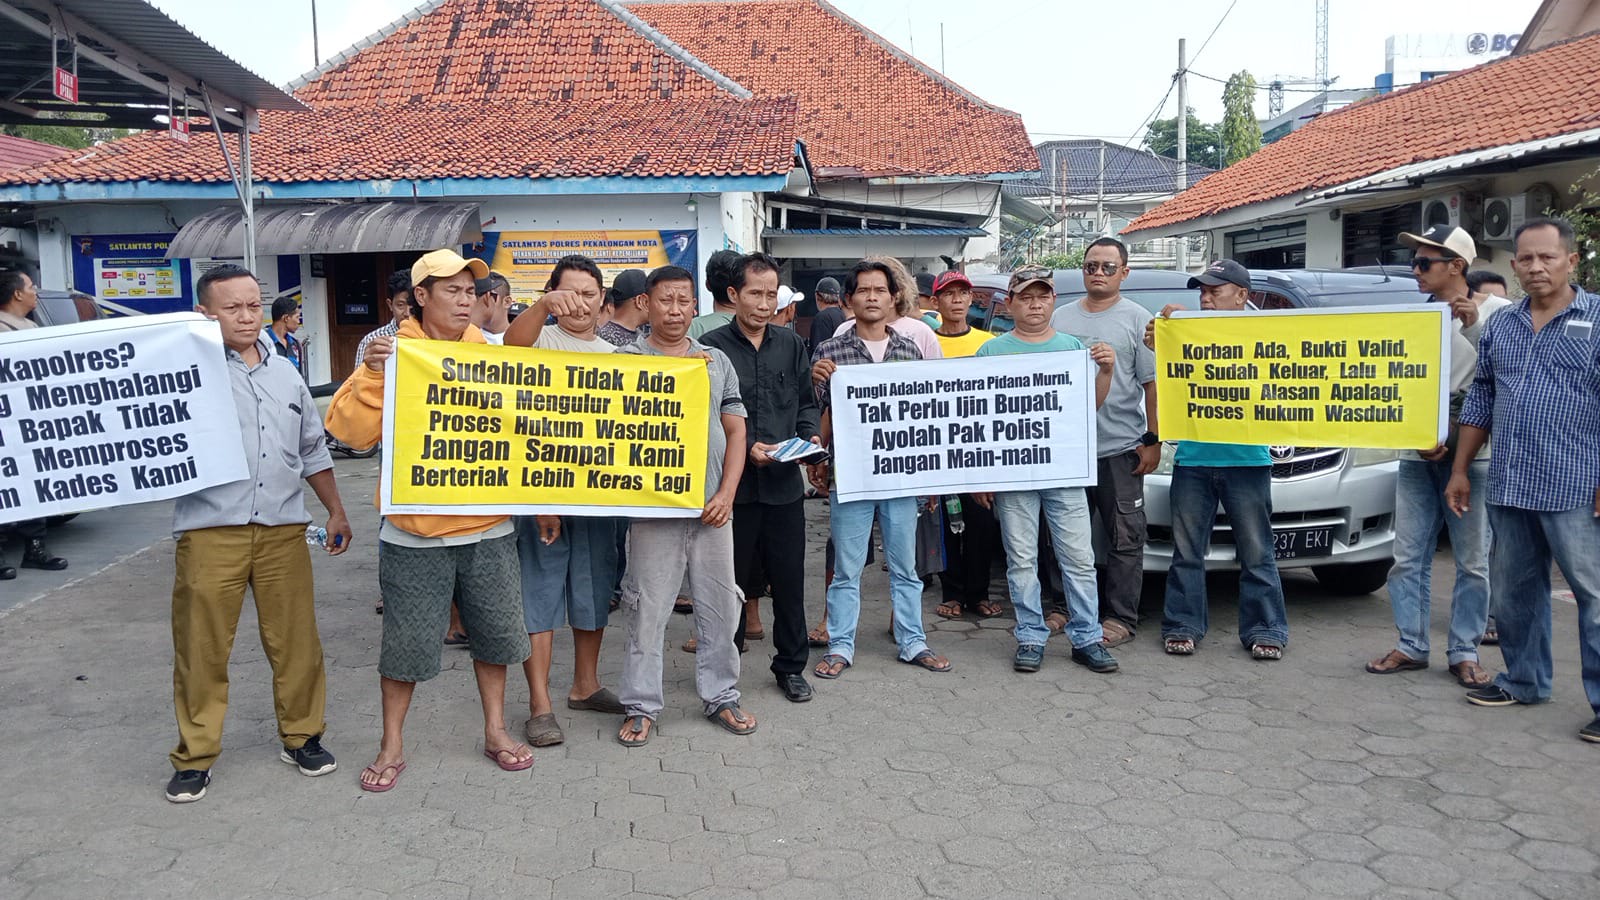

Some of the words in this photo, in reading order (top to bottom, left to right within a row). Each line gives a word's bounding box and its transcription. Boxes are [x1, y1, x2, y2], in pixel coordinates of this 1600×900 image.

[0, 342, 135, 383] Kapolres?
[1182, 343, 1244, 360] Korban
[1254, 341, 1290, 360] Ada,
[1301, 340, 1347, 358] Bukti
[1358, 339, 1408, 359] Valid,
[442, 357, 551, 387] Sudahlah
[565, 365, 624, 391] Tidak
[636, 371, 675, 394] Ada
[846, 382, 888, 400] Pungli
[889, 380, 933, 397] Adalah
[936, 376, 984, 394] Perkara
[987, 373, 1030, 390] Pidana
[1032, 371, 1072, 387] Murni,
[1167, 363, 1194, 379] LHP
[1204, 363, 1258, 380] Sudah
[1269, 362, 1328, 380] Keluar,
[1340, 362, 1376, 379] Lalu
[1388, 361, 1427, 379] Mau
[26, 364, 202, 412] Menghalangi
[426, 384, 503, 410] Artinya
[515, 389, 611, 415] Mengulur
[622, 395, 684, 420] Waktu,
[1188, 383, 1250, 402] Tunggu
[1261, 384, 1320, 400] Alasan
[1331, 383, 1402, 402] Apalagi,
[18, 410, 105, 444] Bapak
[117, 399, 192, 430] Tidak
[858, 401, 892, 424] Tak
[898, 397, 950, 421] Perlu
[956, 394, 988, 419] Ijin
[994, 390, 1062, 415] Bupati,
[1188, 403, 1244, 420] Proses
[1254, 404, 1314, 422] Hukum
[1325, 404, 1404, 422] Wasduki
[429, 410, 501, 434] Proses
[514, 415, 583, 438] Hukum
[596, 419, 680, 444] Wasduki,
[871, 424, 941, 451] Ayolah
[948, 421, 986, 444] Pak
[992, 416, 1050, 442] Polisi
[32, 432, 189, 473] Memproses
[421, 434, 510, 464] Jangan
[525, 438, 614, 467] Sampai
[629, 443, 685, 468] Kami
[872, 452, 941, 475] Jangan
[947, 444, 1051, 469] Main-main
[34, 473, 118, 503] Kades
[131, 456, 198, 491] Kami
[411, 465, 509, 487] Berteriak
[521, 466, 575, 488] Lebih
[586, 470, 643, 491] Keras
[654, 472, 691, 494] Lagi
[1305, 530, 1329, 548] EKI
